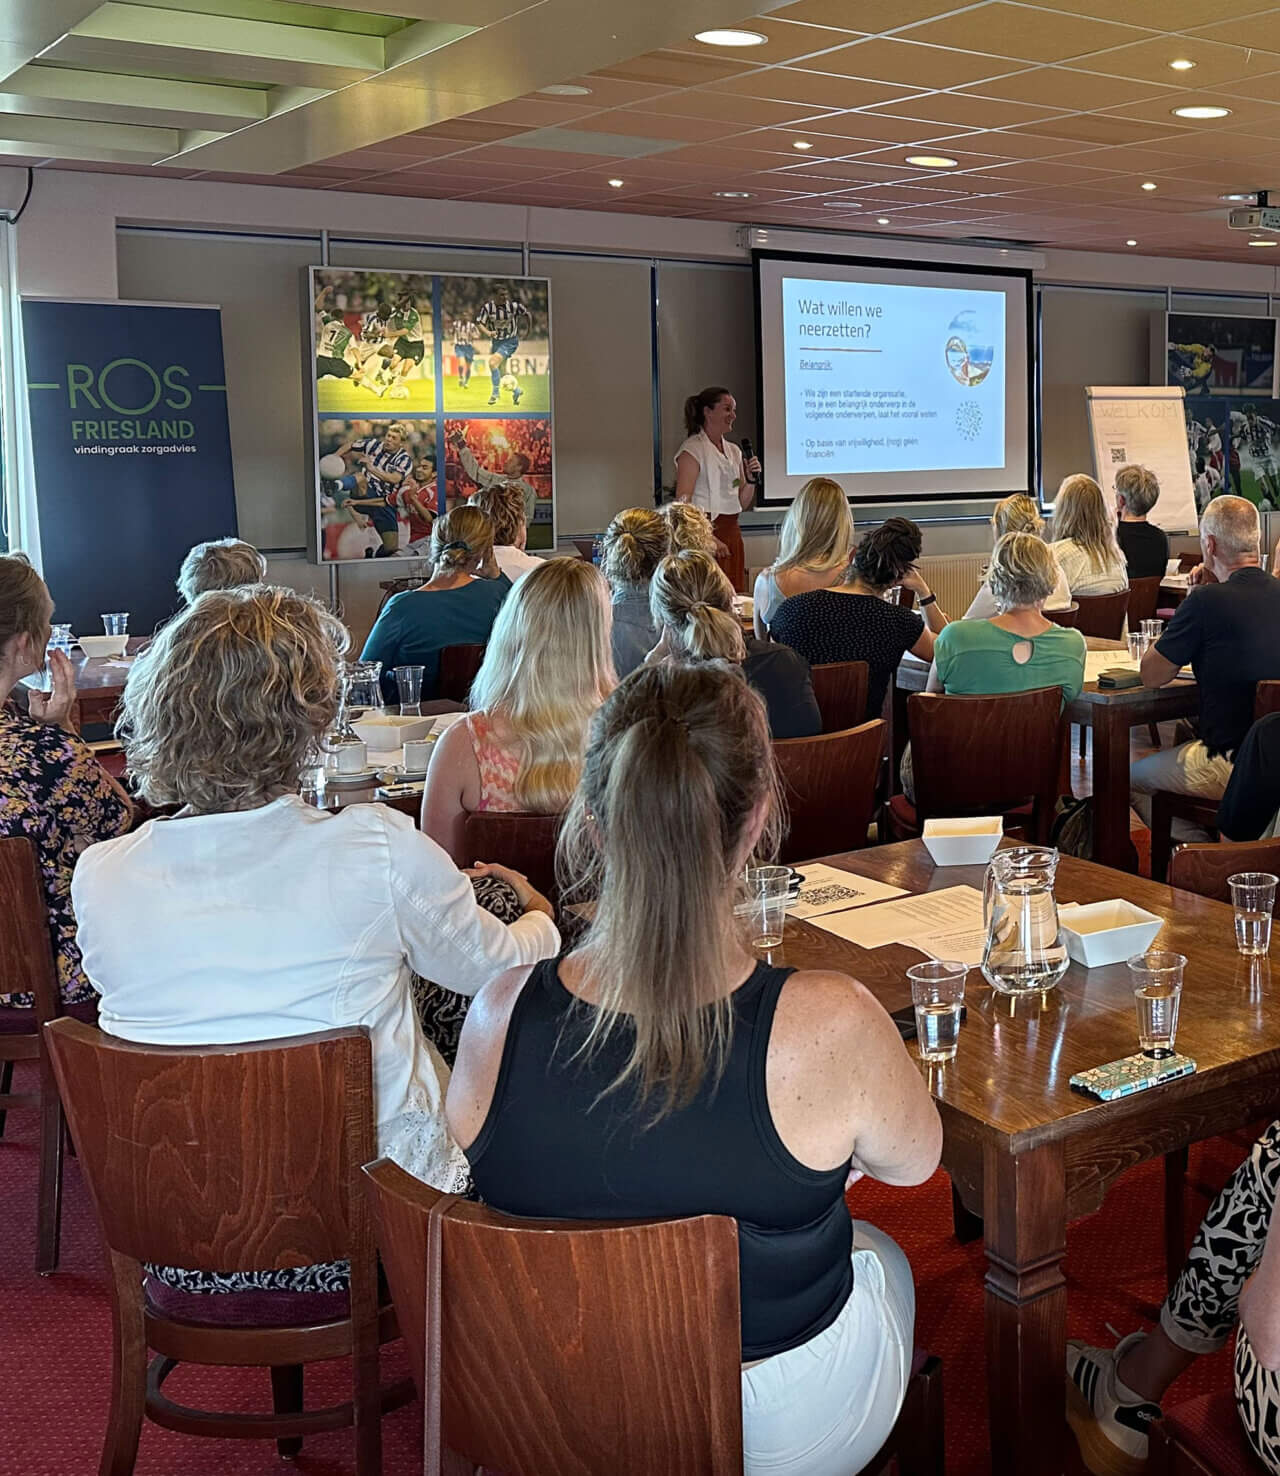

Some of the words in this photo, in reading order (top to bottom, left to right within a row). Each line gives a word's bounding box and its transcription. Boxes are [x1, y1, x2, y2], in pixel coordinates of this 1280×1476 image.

[798, 299, 824, 315] Wat
[828, 301, 862, 316] willen
[865, 305, 883, 318] we
[799, 323, 871, 338] neerzetten?
[67, 358, 192, 415] ROS
[838, 400, 867, 410] belangrijk
[869, 400, 900, 410] onderwerp
[804, 410, 833, 420] volgende
[72, 420, 194, 440] FRIESLAND
[74, 445, 139, 456] vindingraak
[141, 444, 197, 455] zorgadvies
[804, 438, 815, 449] Op
